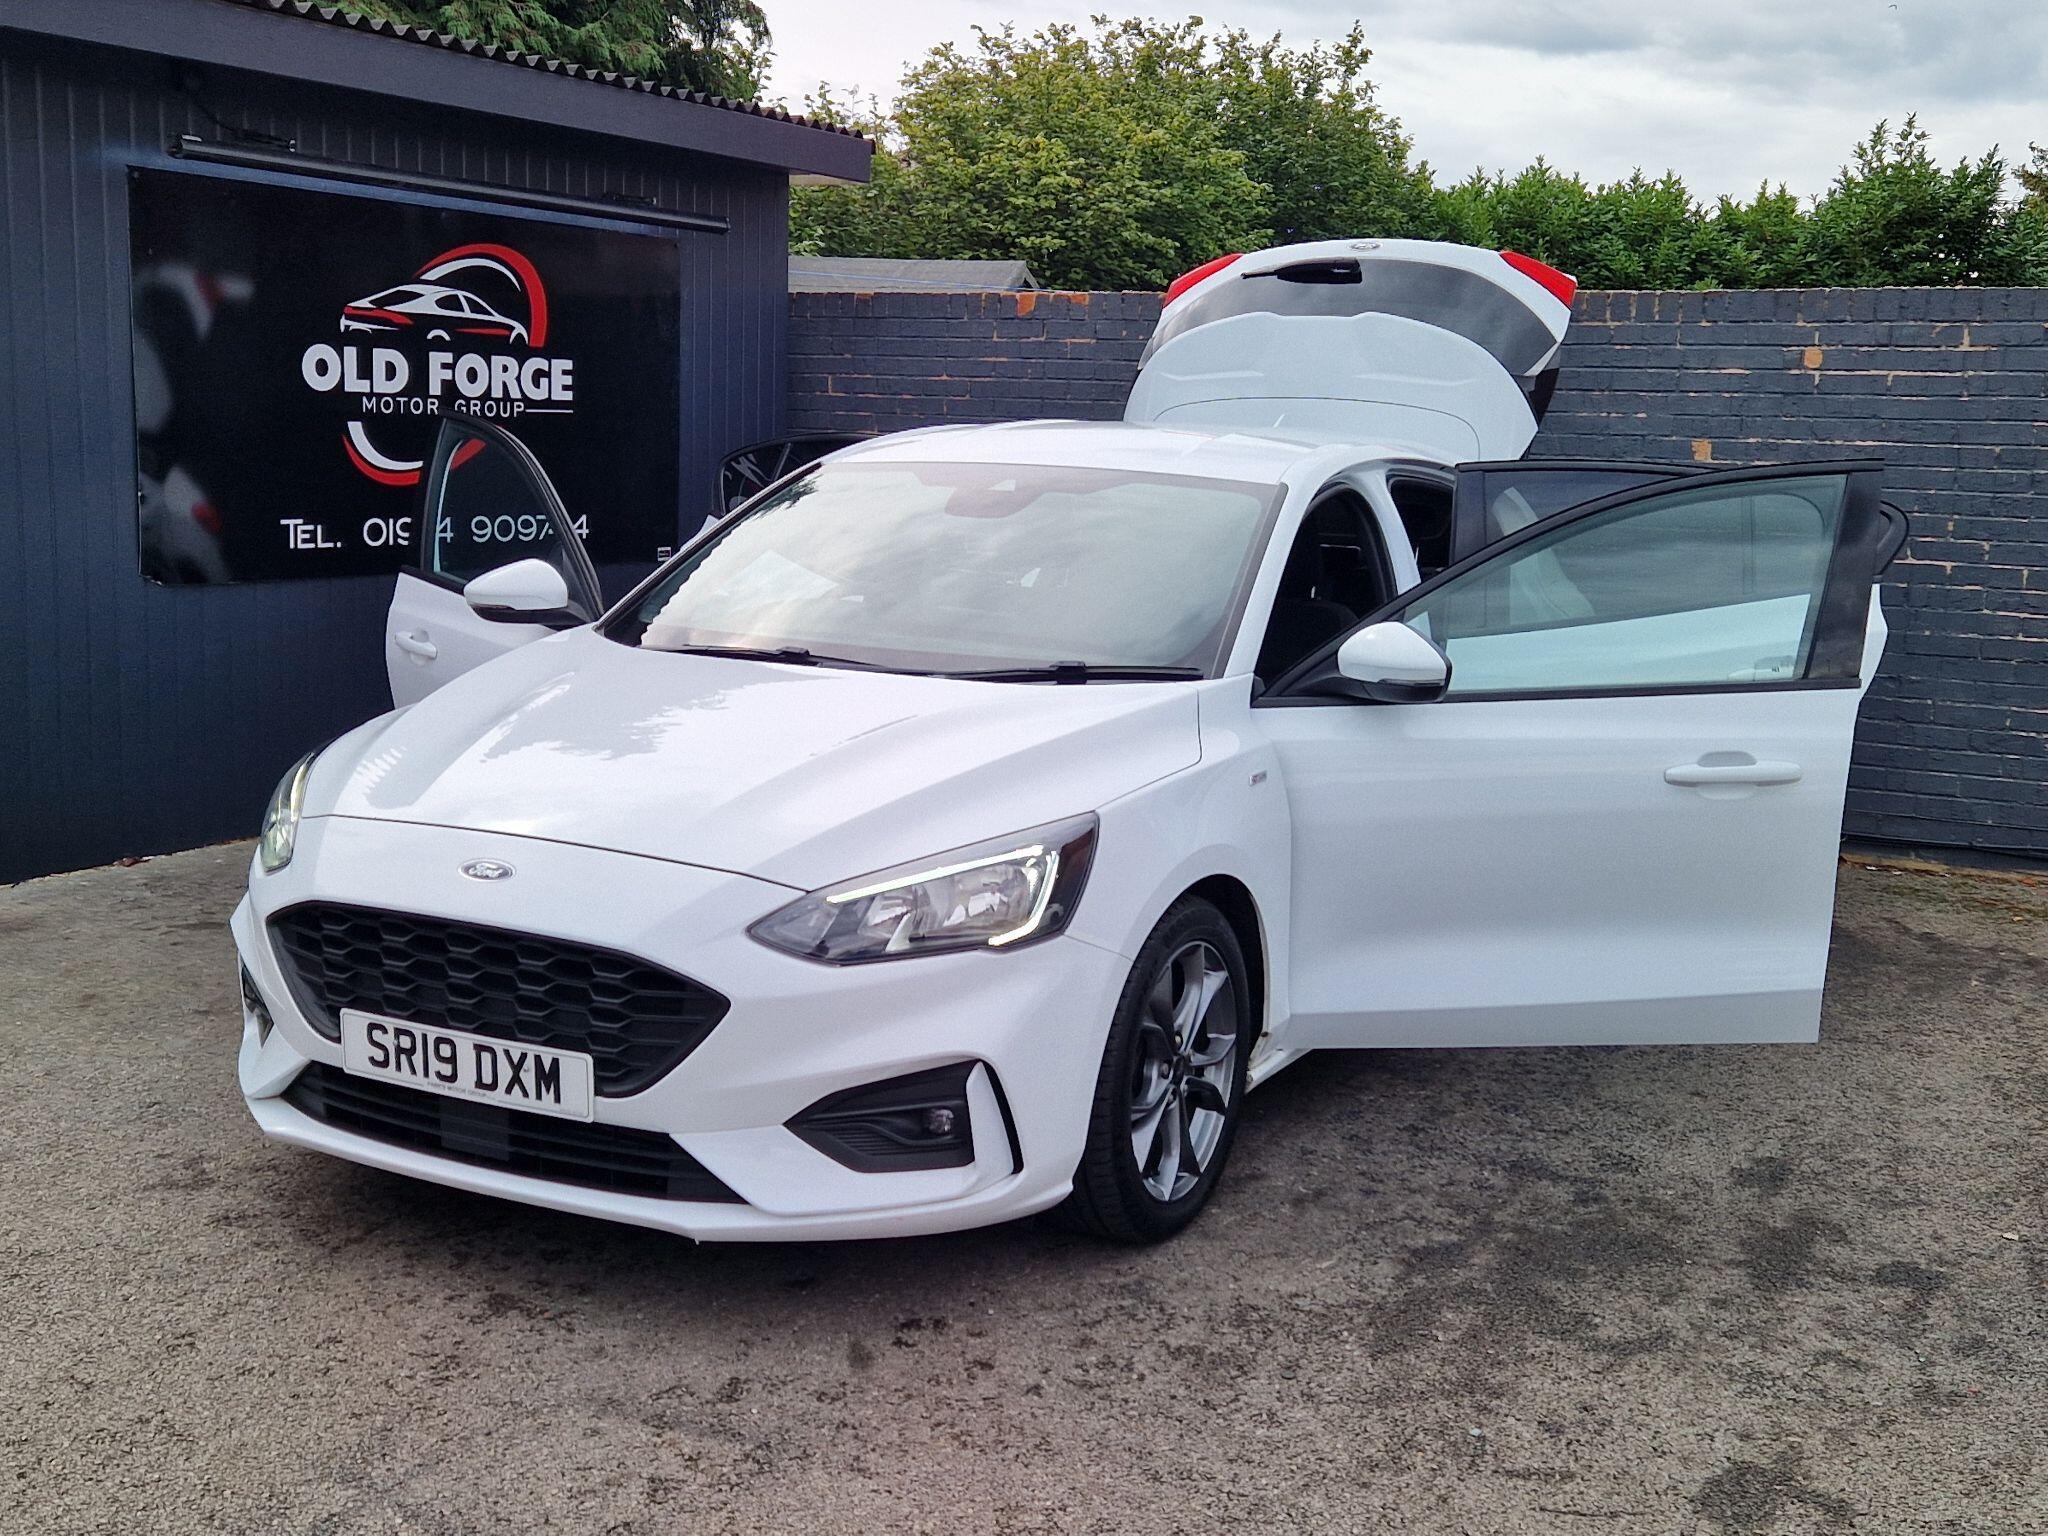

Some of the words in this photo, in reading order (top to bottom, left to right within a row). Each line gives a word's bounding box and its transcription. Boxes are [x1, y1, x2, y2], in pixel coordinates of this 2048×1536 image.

[301, 343, 409, 394] OLD
[428, 351, 574, 401] FORGE
[362, 396, 439, 415] MOTOR
[454, 399, 524, 418] GROUP
[363, 516, 454, 547] 0194
[471, 513, 590, 543] 90974
[366, 1022, 459, 1084] SR19
[472, 1042, 562, 1104] DXM
